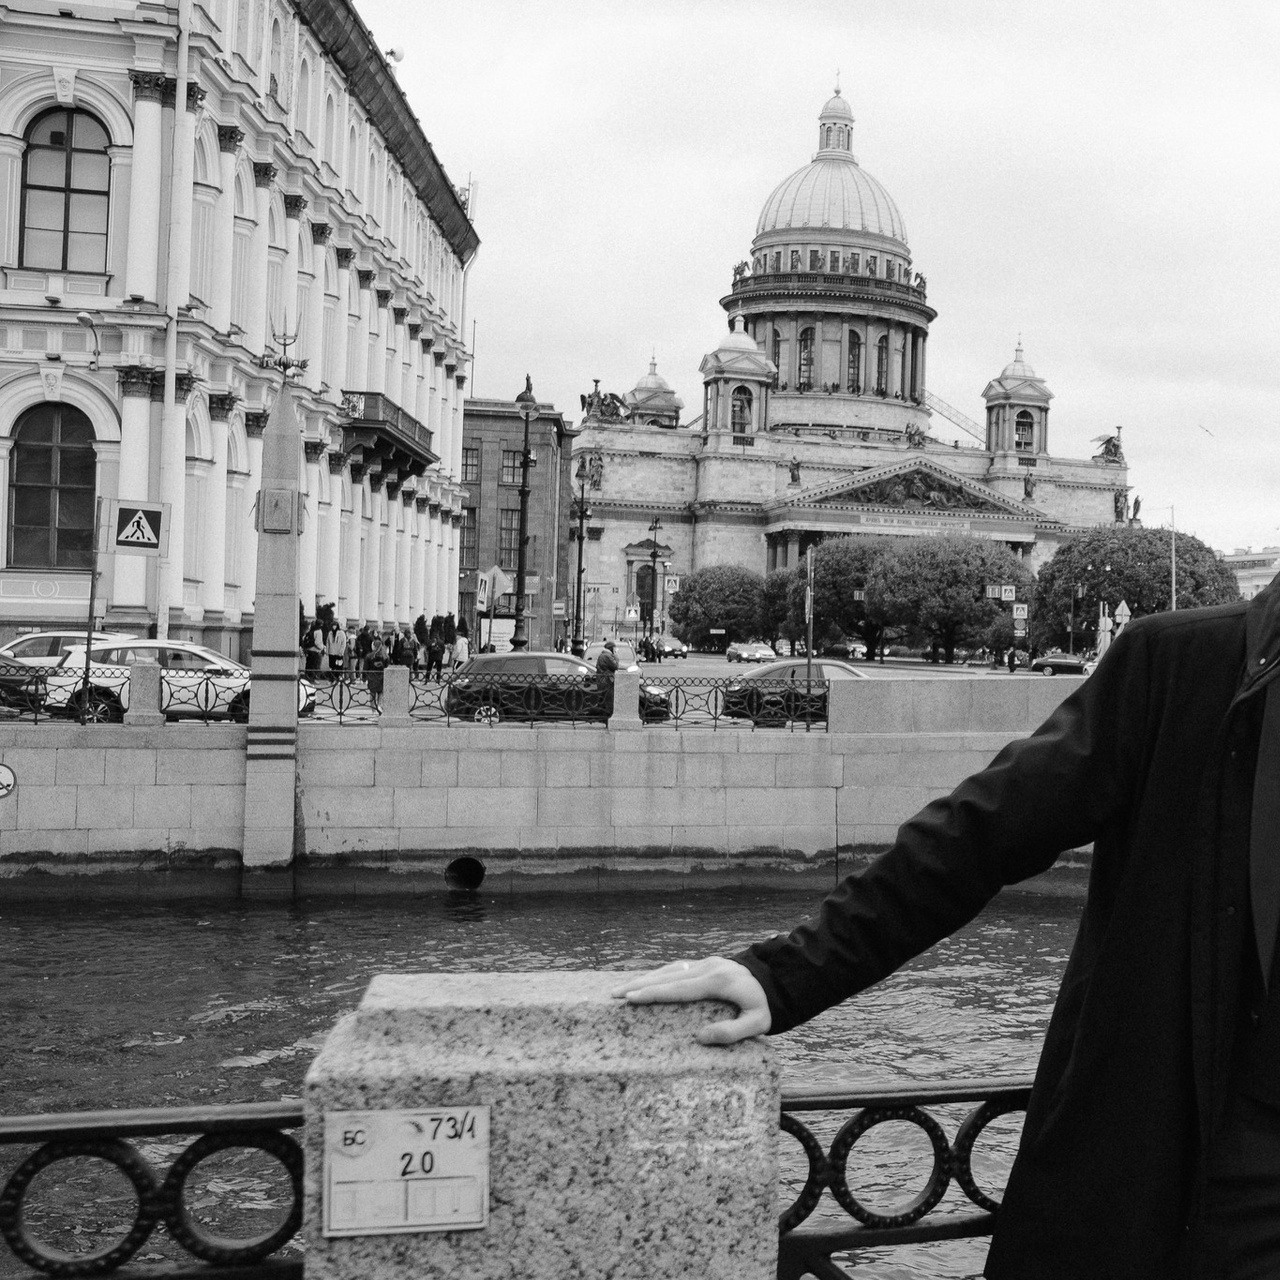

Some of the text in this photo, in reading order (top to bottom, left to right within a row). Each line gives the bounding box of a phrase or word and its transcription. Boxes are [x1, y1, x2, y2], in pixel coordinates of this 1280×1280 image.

[343, 1129, 366, 1147] БС
[430, 1111, 475, 1140] 73/1
[401, 1151, 434, 1177] 20
